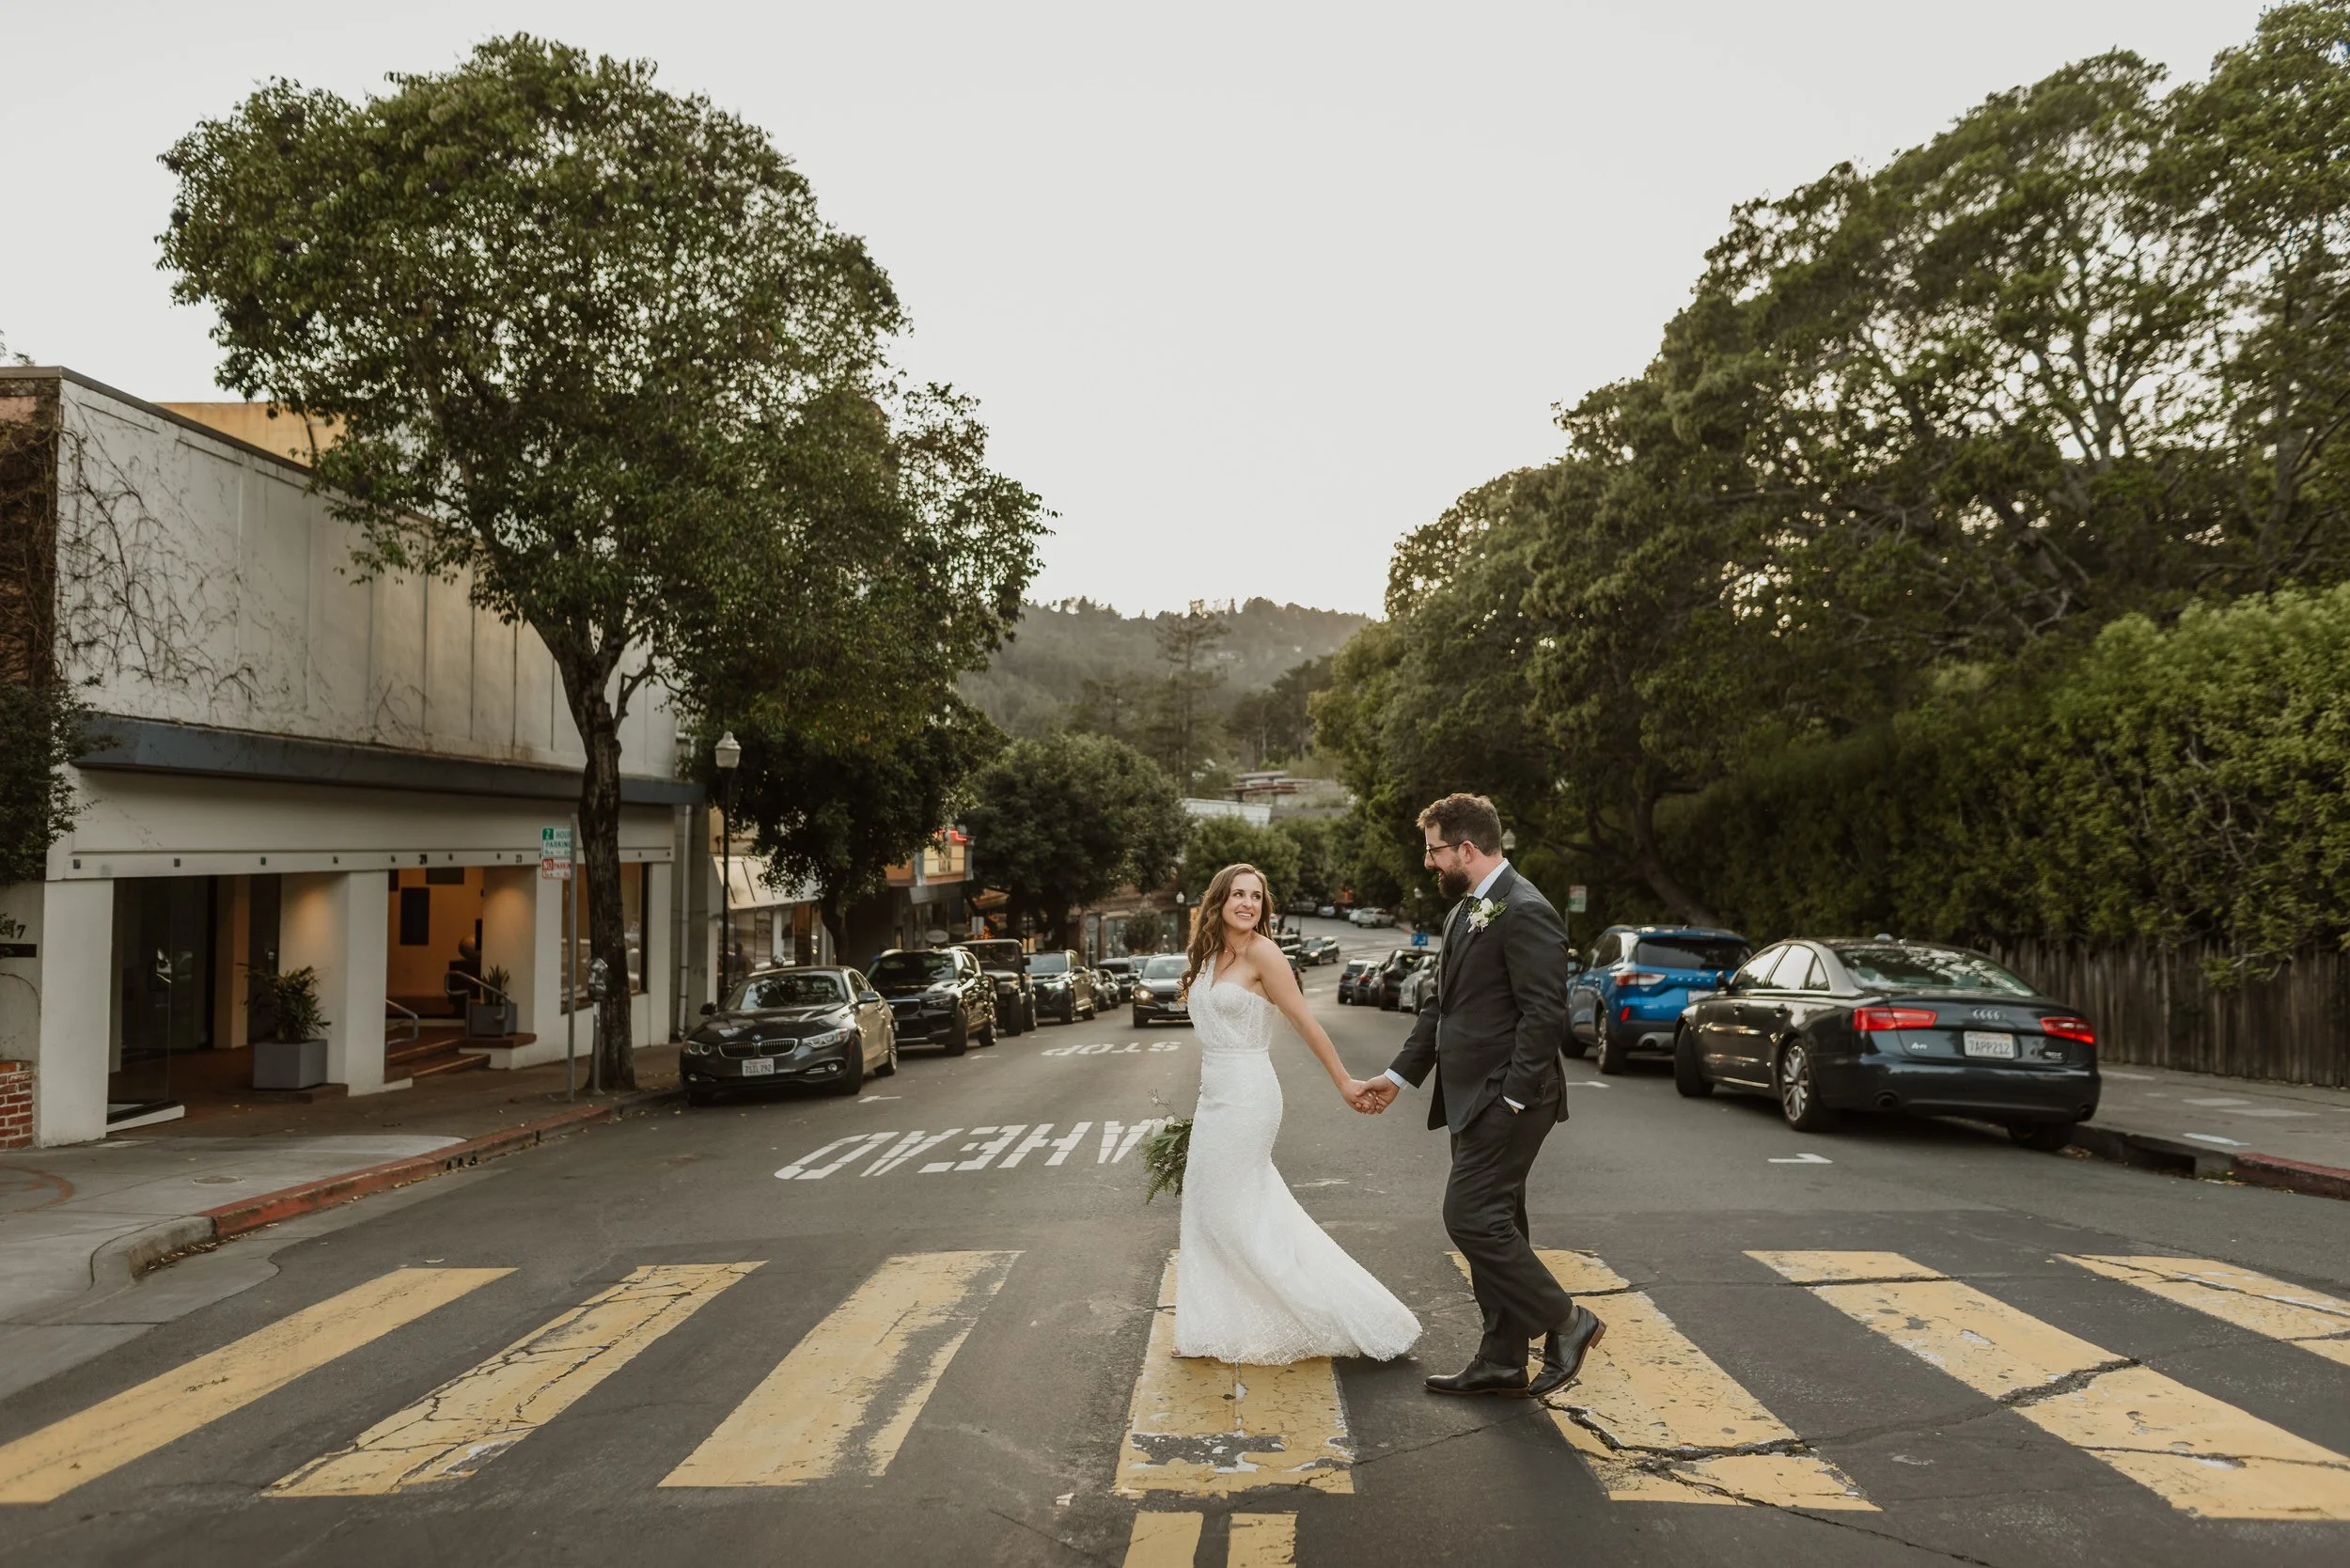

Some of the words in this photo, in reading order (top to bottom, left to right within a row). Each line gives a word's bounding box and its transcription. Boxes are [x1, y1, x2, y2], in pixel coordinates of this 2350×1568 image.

[543, 860, 553, 870] NO
[1041, 1041, 1182, 1057] STOP
[774, 1119, 1153, 1180] AHEAD
